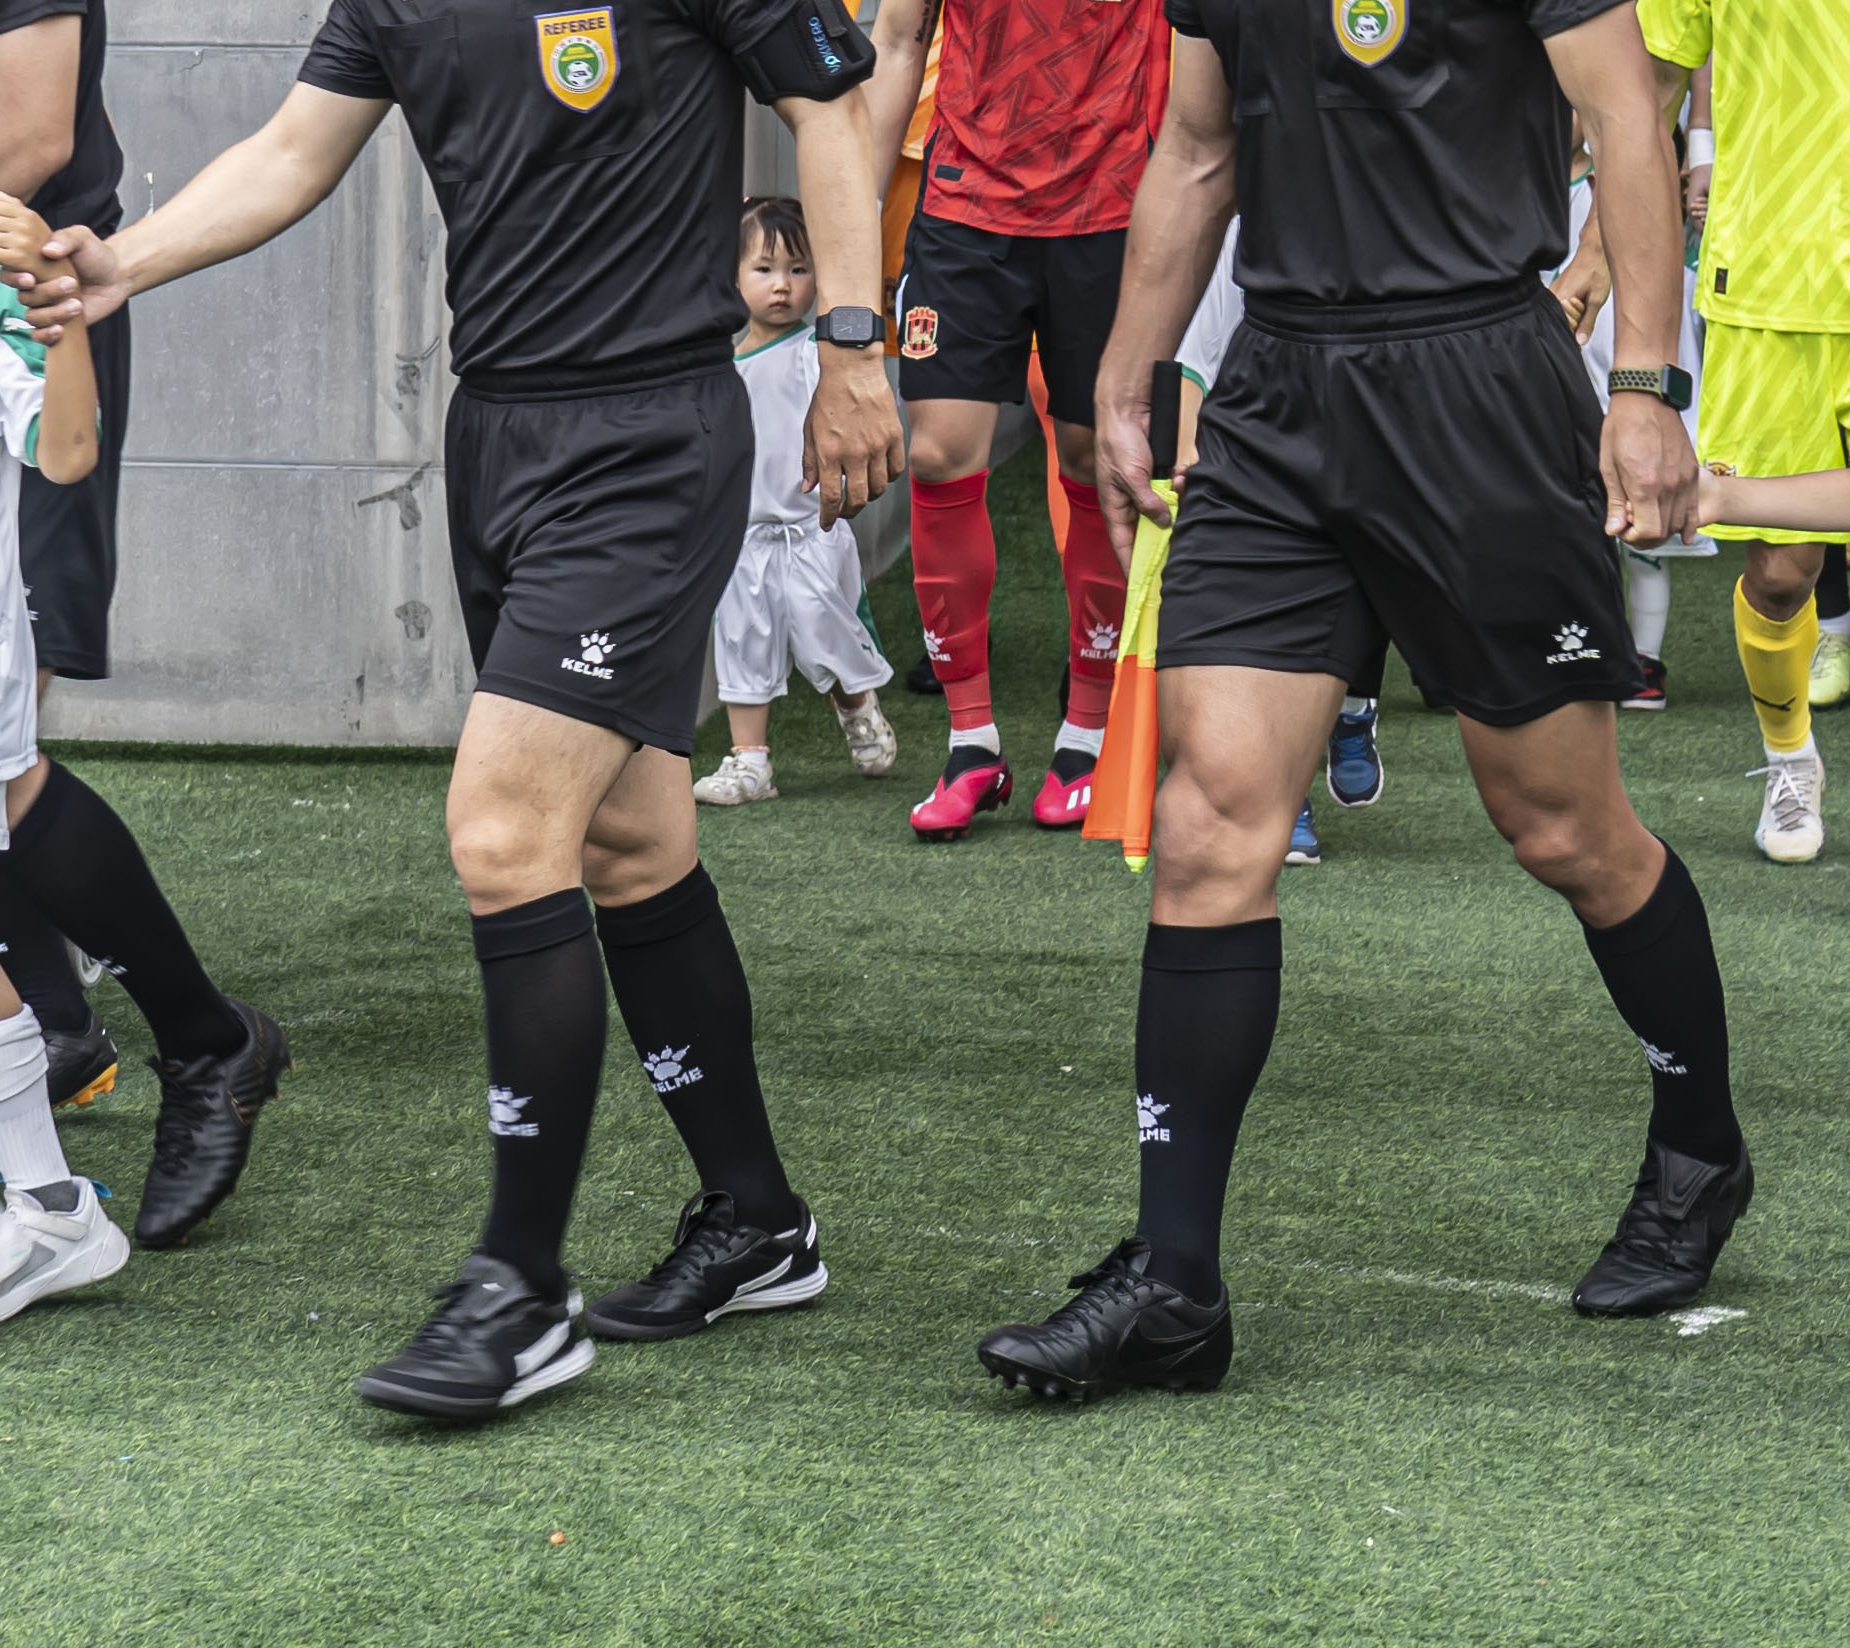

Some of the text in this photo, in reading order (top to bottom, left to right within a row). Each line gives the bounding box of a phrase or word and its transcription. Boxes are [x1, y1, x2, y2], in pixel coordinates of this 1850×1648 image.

[543, 16, 607, 36] REFEREE
[1546, 649, 1602, 665] KELME
[561, 658, 615, 680] KELME
